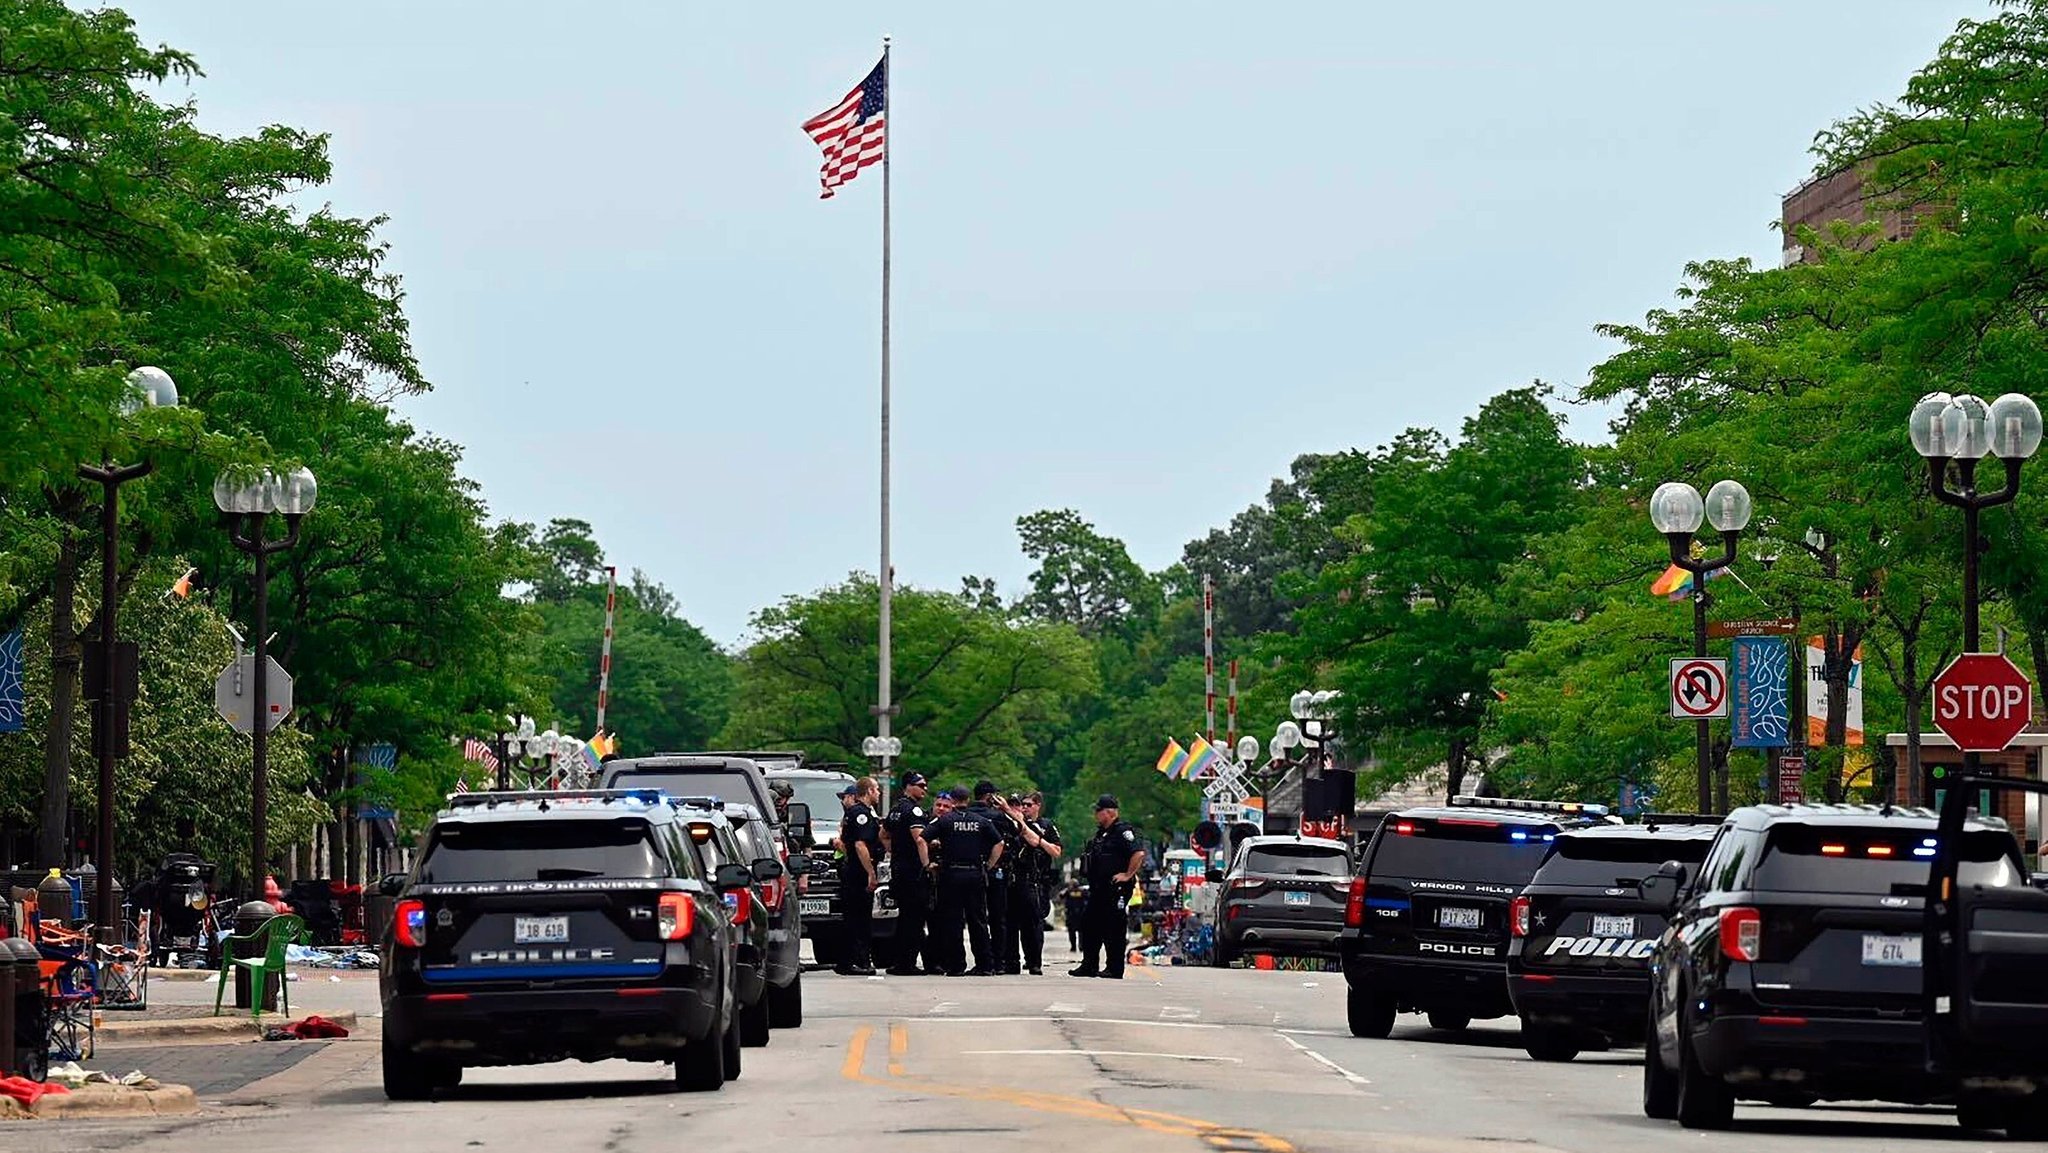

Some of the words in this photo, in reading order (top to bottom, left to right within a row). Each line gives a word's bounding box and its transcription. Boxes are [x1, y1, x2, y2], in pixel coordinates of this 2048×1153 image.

[1941, 685, 2023, 719] STOP
[954, 822, 979, 832] POLICE
[432, 885, 499, 894] VILLAGE
[506, 884, 528, 892] OF
[557, 881, 642, 890] GLENVIEW
[1411, 882, 1466, 891] VERNON
[1475, 886, 1514, 894] HILLS
[629, 907, 652, 919] 15
[527, 924, 540, 938] 18
[545, 923, 564, 937] 618
[1616, 921, 1631, 934] 317
[1420, 943, 1496, 956] POLICE
[1544, 937, 1660, 959] POLIC
[1882, 945, 1904, 960] 674
[471, 949, 614, 963] POLICE
